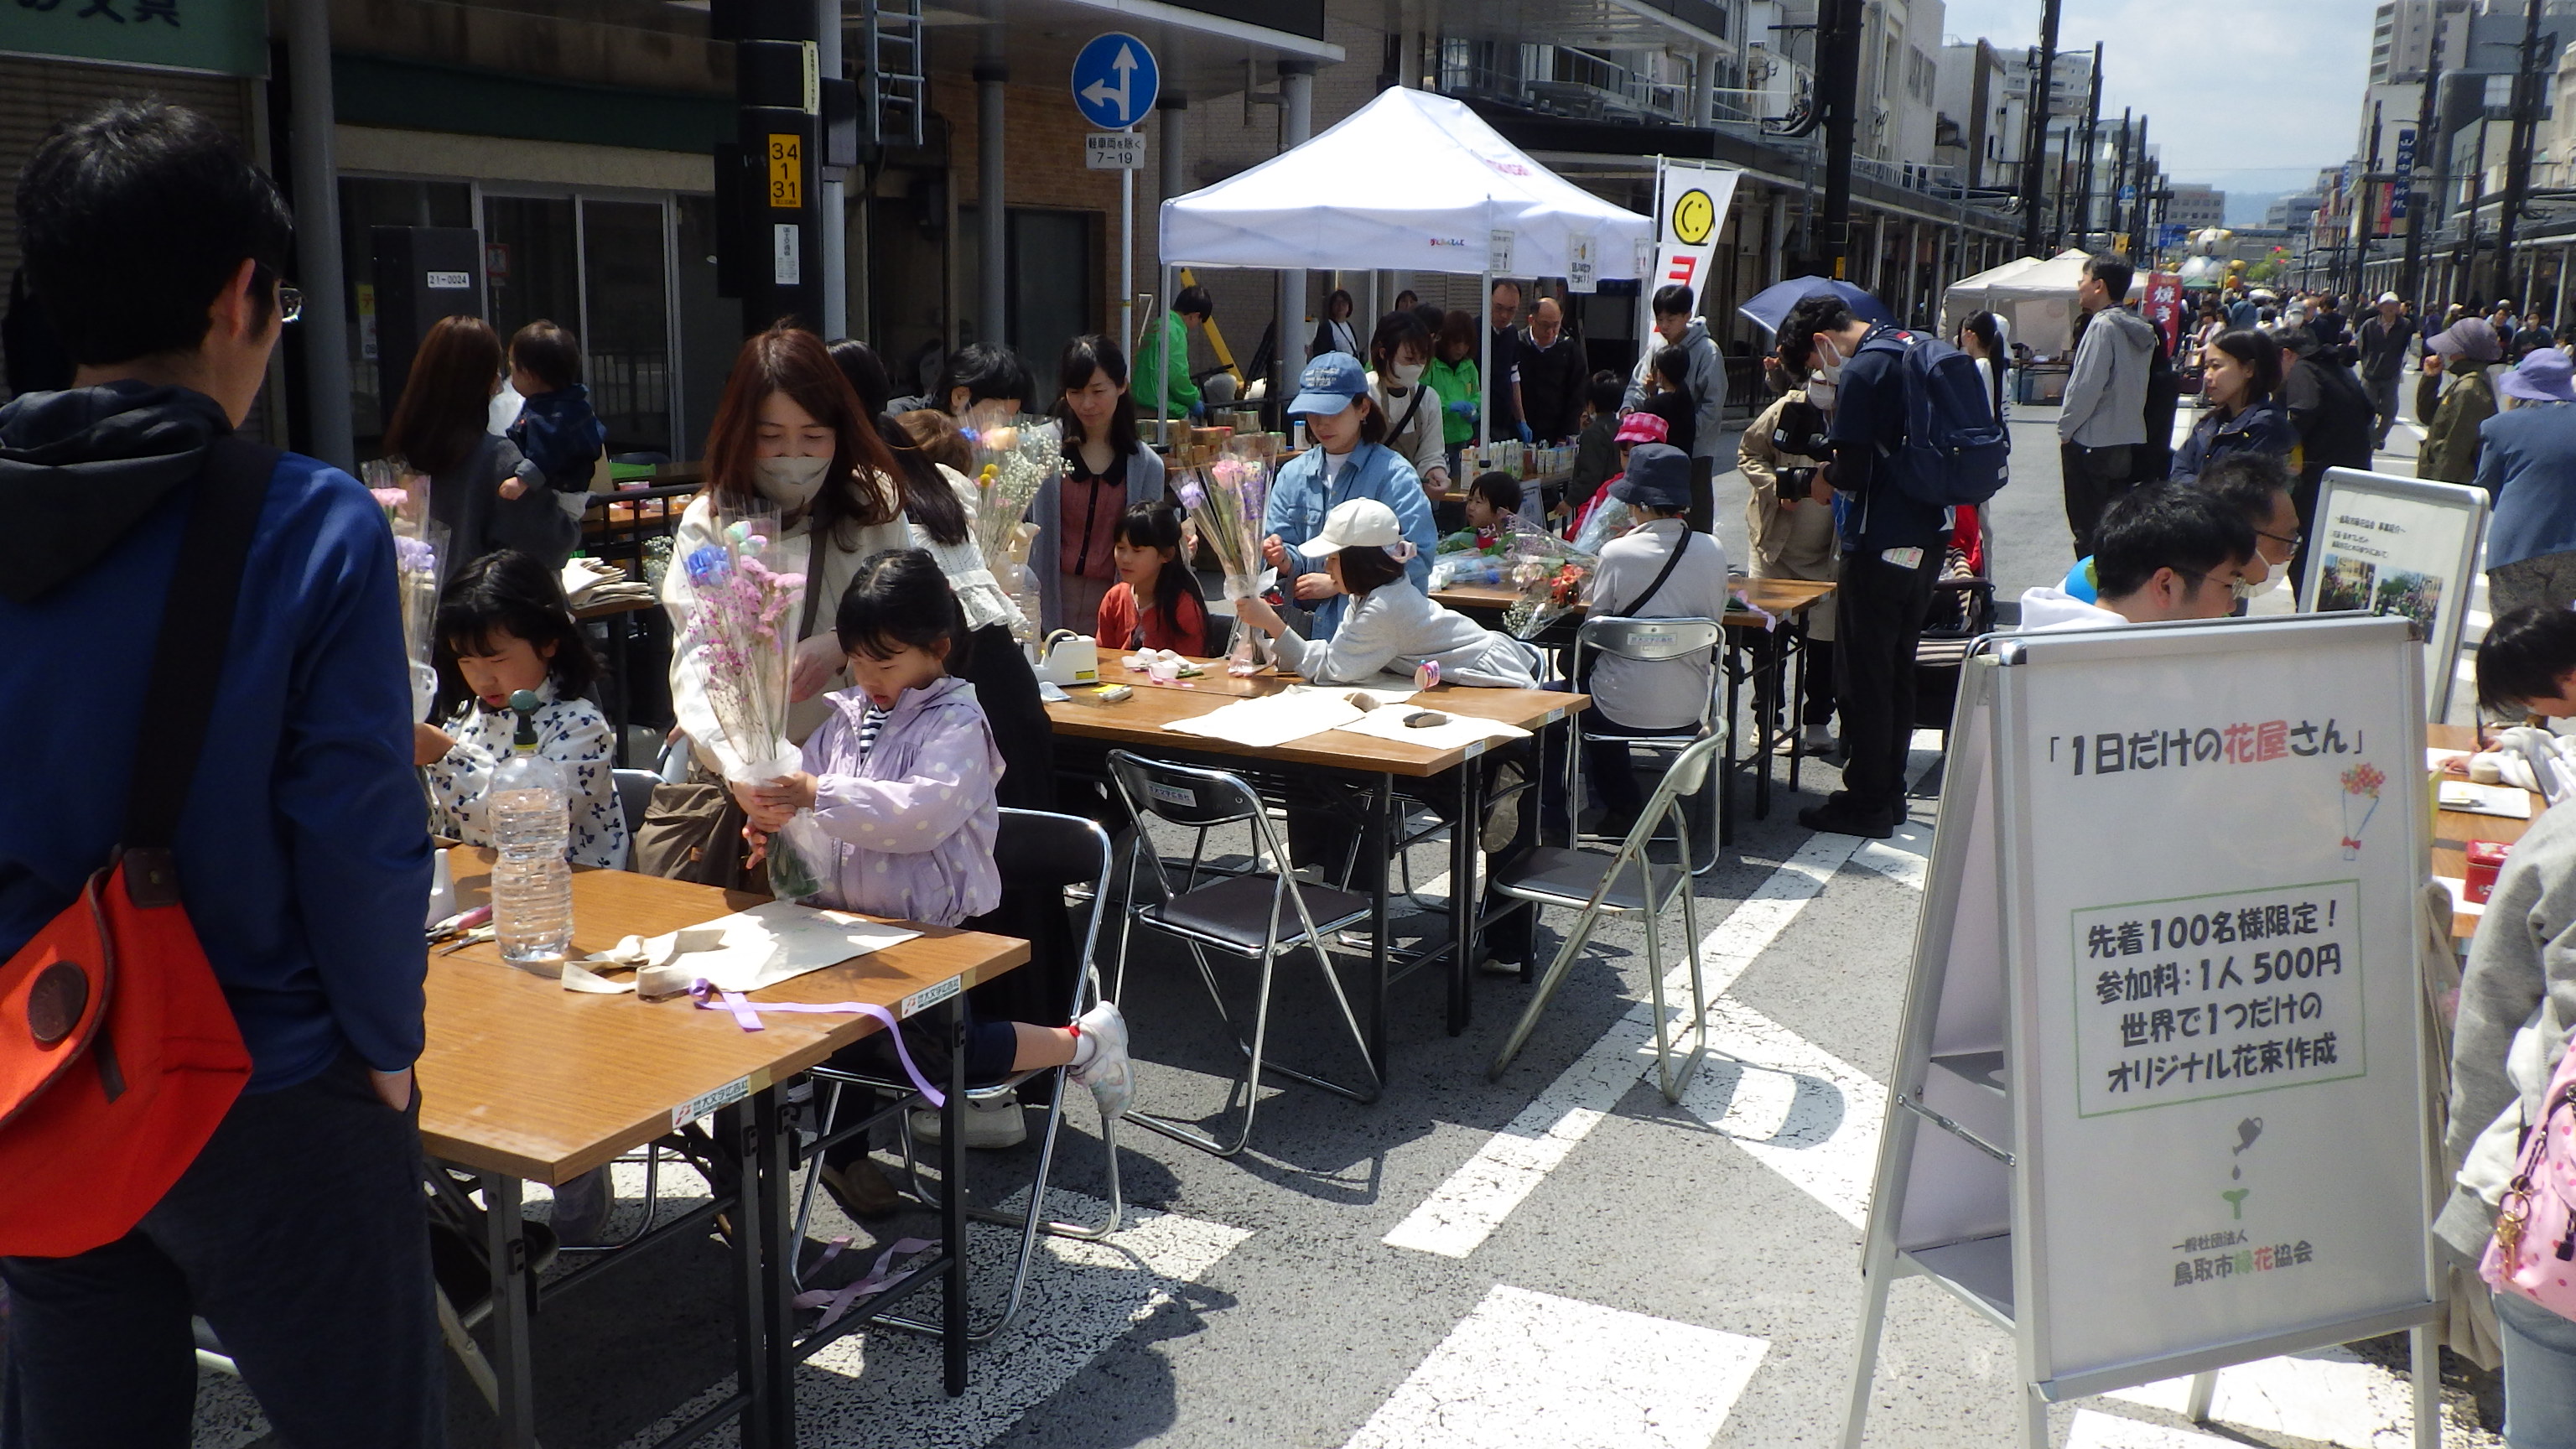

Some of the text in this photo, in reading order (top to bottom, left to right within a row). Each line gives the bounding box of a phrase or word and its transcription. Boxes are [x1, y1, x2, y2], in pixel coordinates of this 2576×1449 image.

[771, 143, 798, 161] 34
[1088, 138, 1141, 150] 軽車両を除く
[781, 162, 788, 179] 1
[1097, 152, 1133, 164] 7-19
[772, 180, 797, 199] 31
[428, 274, 467, 285] 21-0024
[2049, 719, 2365, 776] 「1日だけの花屋さん」
[2088, 899, 2337, 958] 先着100名様限定！
[2253, 943, 2342, 984] 500円
[2121, 991, 2323, 1048] 世界で1つだけの
[2107, 1031, 2337, 1093] オリジナル花束作成
[2172, 1228, 2249, 1253] 一般社団法人
[2174, 1239, 2314, 1287] 鳥取市緑花協会
